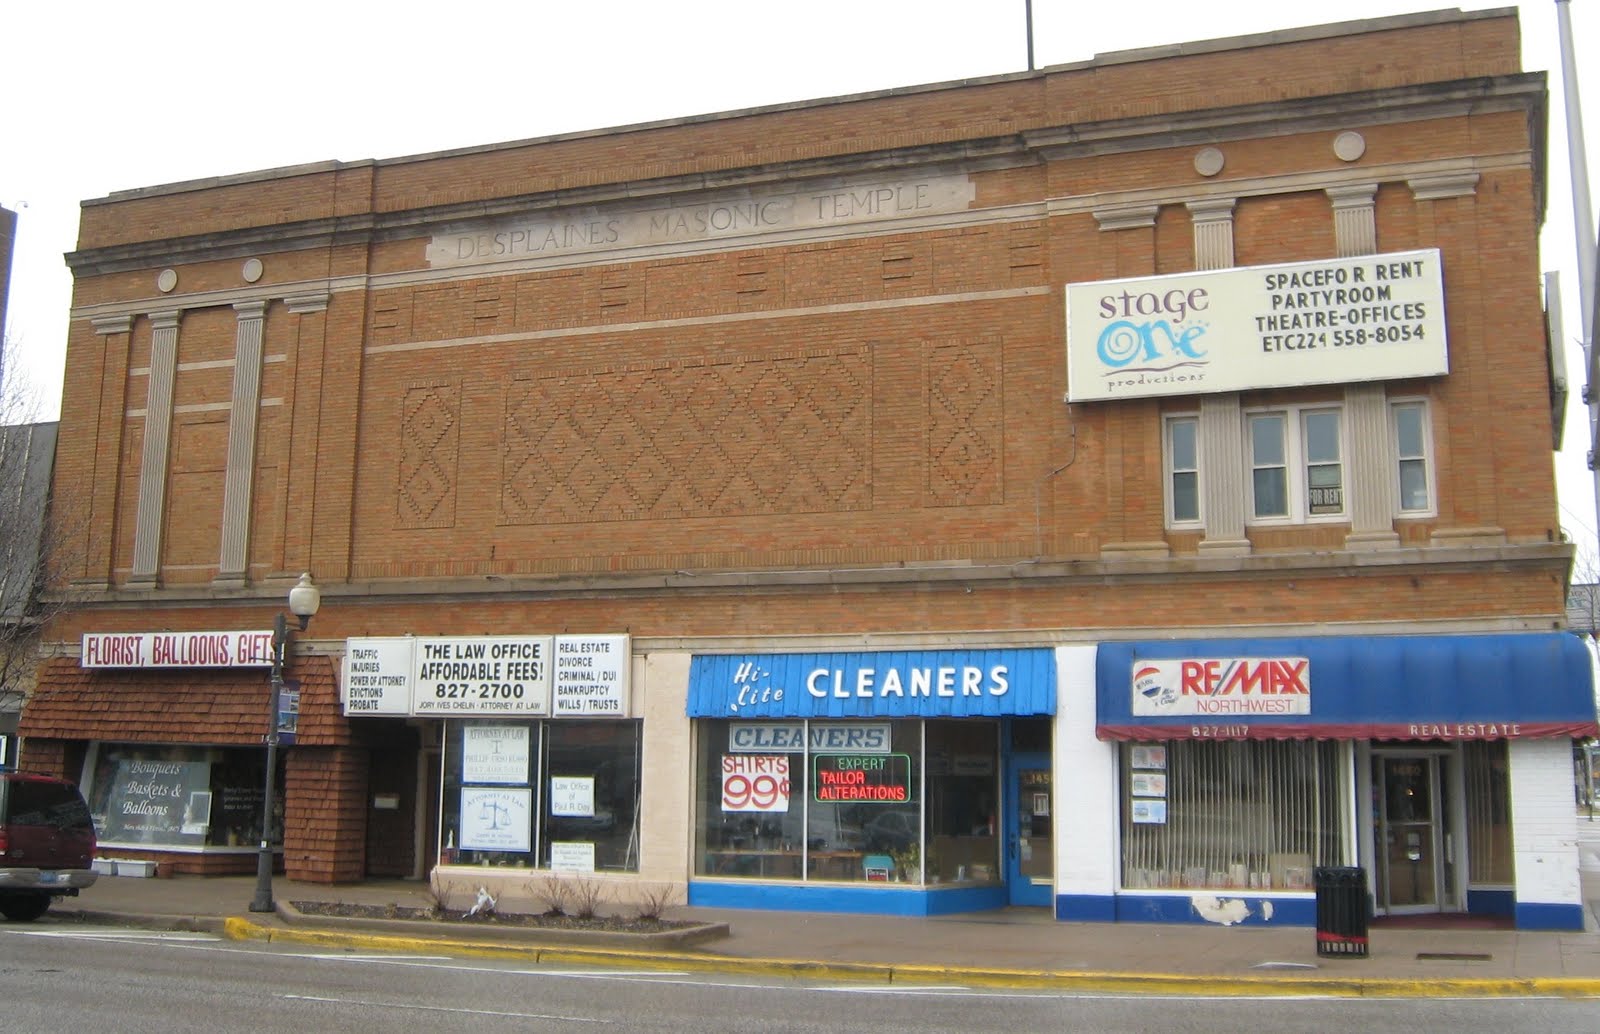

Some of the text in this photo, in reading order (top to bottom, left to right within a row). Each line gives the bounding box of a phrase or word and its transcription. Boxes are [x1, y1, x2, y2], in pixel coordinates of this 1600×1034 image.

[457, 184, 932, 260] DESPLAINES MASONIC TEMPLE
[1376, 261, 1424, 281] RENT
[1099, 287, 1209, 323] stage
[1272, 284, 1392, 311] PARTYROOM
[1255, 302, 1427, 332] THEATRE-OFFICES
[1333, 323, 1425, 347] 558-8054
[87, 636, 145, 667] FLORIST,
[152, 634, 234, 667] BALLOONS,
[352, 649, 378, 660] TRAFFIC
[424, 643, 541, 660] THE LAW OFFICE
[559, 643, 610, 653] REAL ESTATE
[350, 662, 380, 673] INJURIES
[559, 657, 593, 667] DIVORCE
[420, 661, 544, 681] AFFORDABLE FEES!
[558, 671, 595, 681] CRIMINAL
[602, 670, 617, 681] DUI
[734, 662, 770, 684] Hi-
[1181, 660, 1309, 697] RE/MAX
[350, 676, 406, 686] POWER OF ATTORNEY
[806, 665, 1009, 698] CLEANERS
[350, 688, 384, 698] EVICTIONS
[435, 683, 525, 699] 827-2700
[558, 685, 610, 696] BANKRUPTCY
[349, 700, 378, 710] PROBATE
[419, 701, 541, 710] JORY IVES CHELIN ATTORNEY AT LAW
[558, 700, 581, 710] WILLS
[588, 700, 619, 710] TRUSTS
[1197, 700, 1294, 713] NORTHWEST
[735, 727, 885, 748] CLEANERS
[1192, 726, 1249, 737] 827-1117
[1410, 724, 1520, 736] REAL ESTATE
[131, 761, 180, 779] Bouquets
[722, 756, 788, 774] SHIRTS
[838, 758, 886, 770] EXPERT
[820, 771, 865, 785] TAILOR
[127, 780, 182, 798] Baskets &
[556, 782, 568, 790] Law
[820, 786, 905, 800] ALTERATIONS
[122, 800, 168, 816] Balloons
